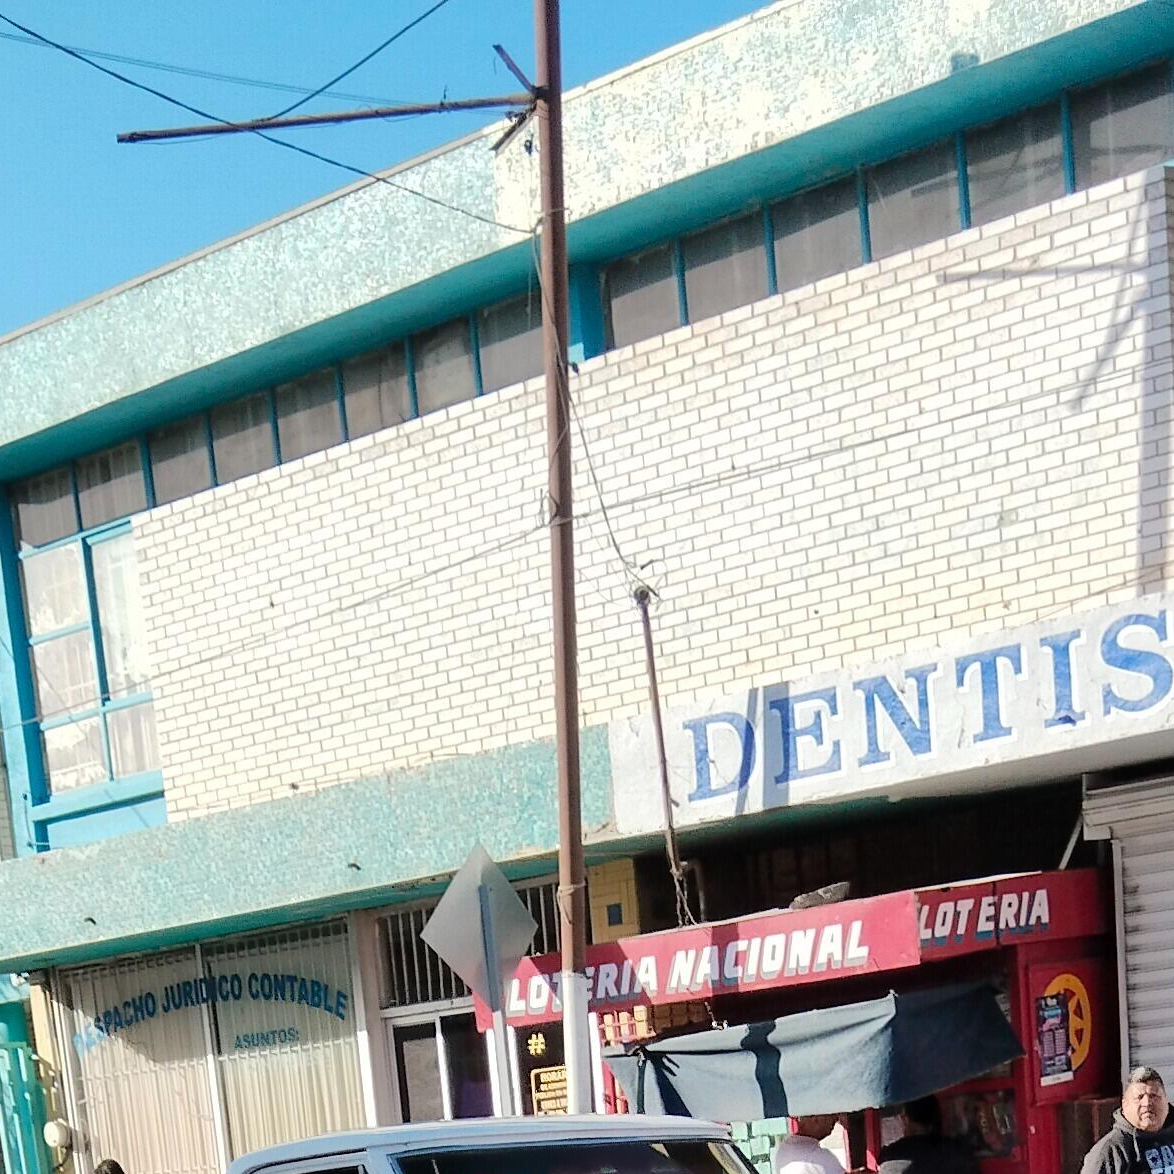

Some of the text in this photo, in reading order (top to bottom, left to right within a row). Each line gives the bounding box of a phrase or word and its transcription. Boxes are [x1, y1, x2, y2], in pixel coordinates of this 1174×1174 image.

[682, 609, 1173, 803] DENTIS
[919, 888, 1050, 940] LOTERIA
[669, 919, 869, 990] NACIONAL
[248, 972, 348, 1021] CONTABLE
